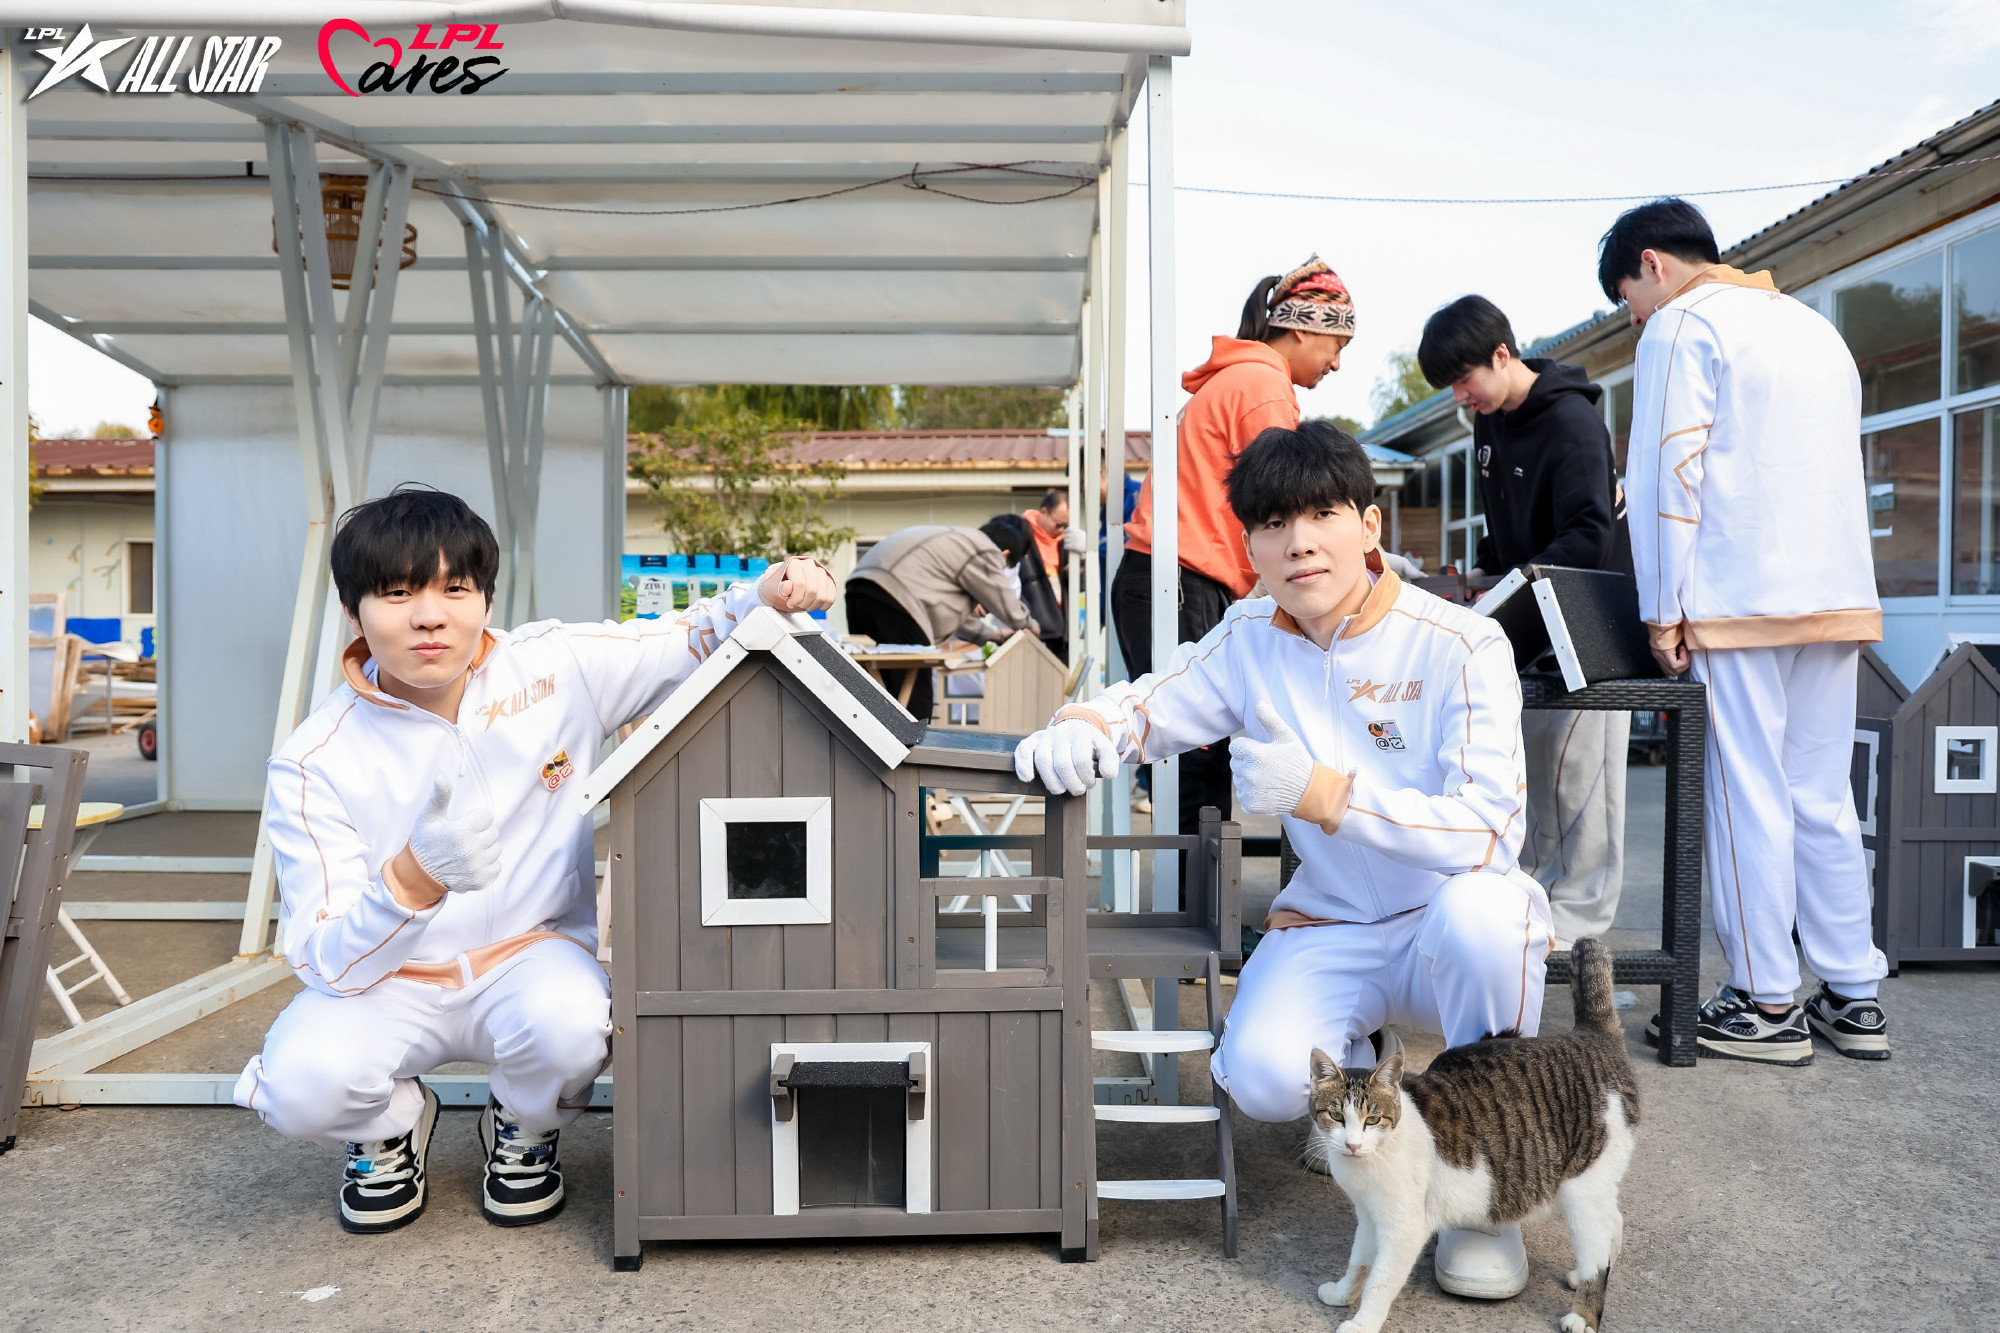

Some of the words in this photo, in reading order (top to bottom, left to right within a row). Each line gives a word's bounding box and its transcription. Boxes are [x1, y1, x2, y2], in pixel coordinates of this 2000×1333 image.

[644, 582, 666, 590] ZIWI
[511, 687, 530, 717] ALL
[531, 673, 555, 704] STAR
[1378, 681, 1403, 703] ALL
[1401, 679, 1424, 702] STA
